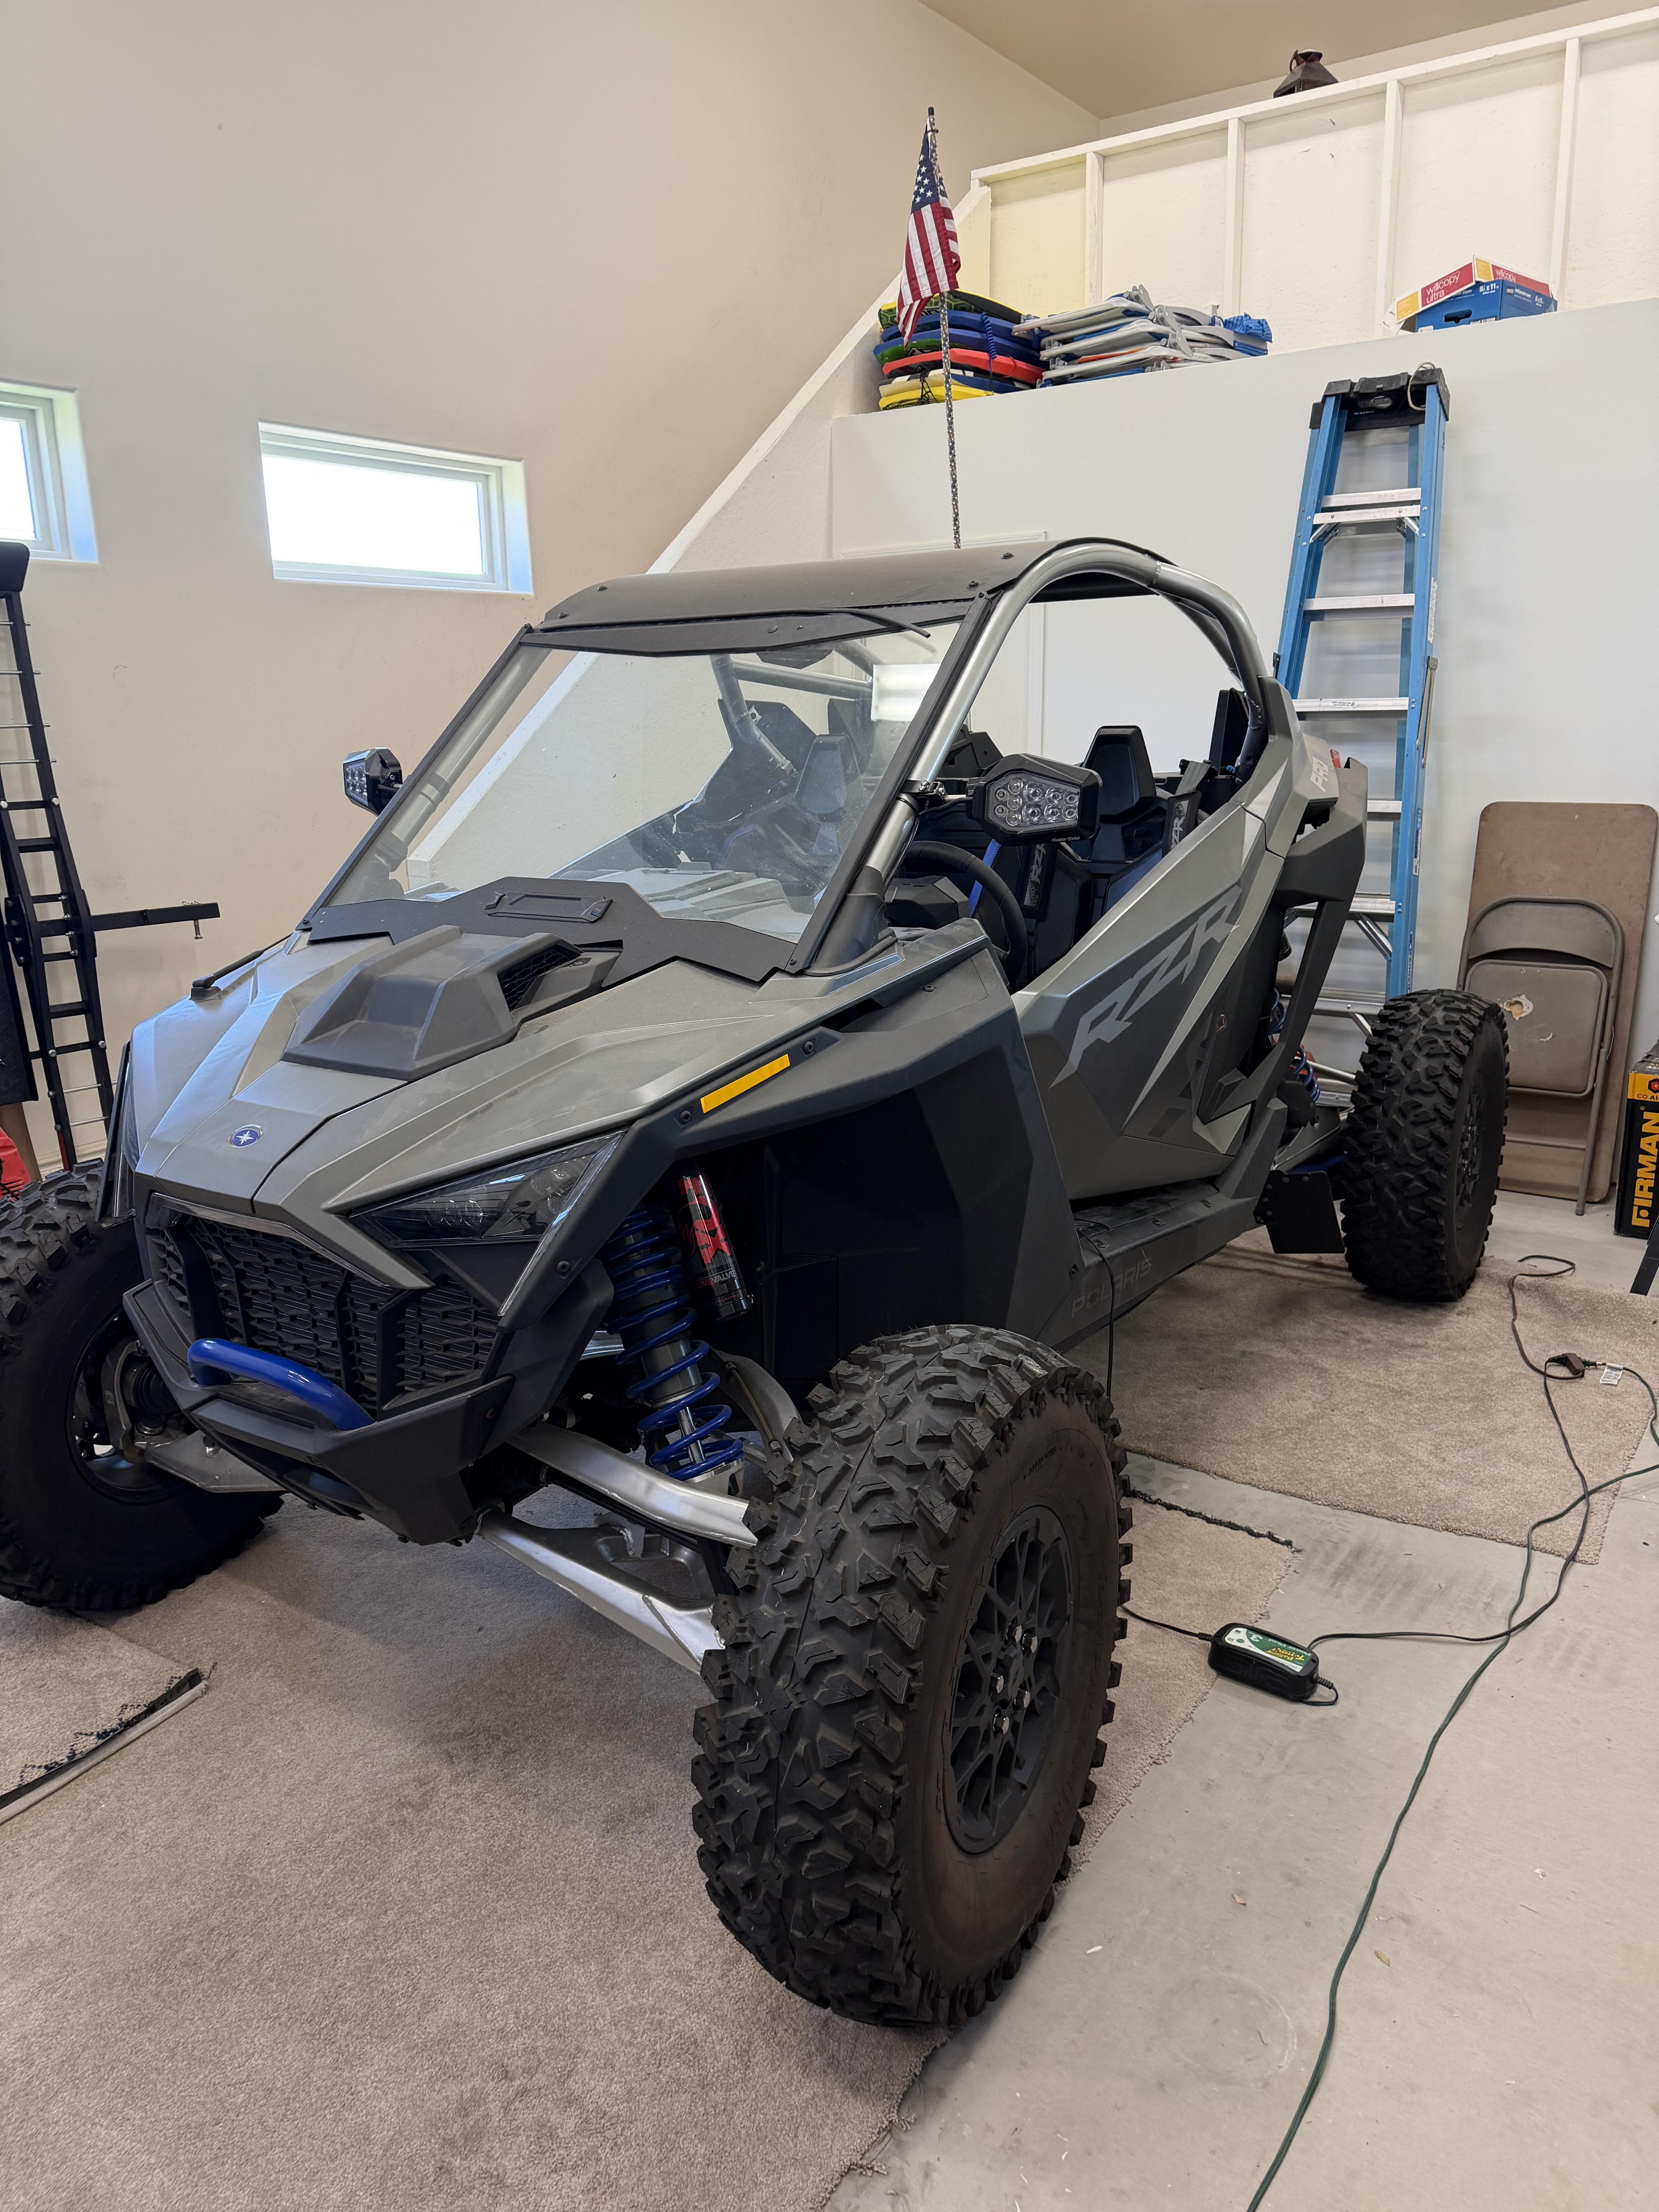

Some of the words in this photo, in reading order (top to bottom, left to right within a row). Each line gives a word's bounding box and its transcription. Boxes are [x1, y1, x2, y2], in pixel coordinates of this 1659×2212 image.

[1426, 271, 1460, 295] willcopy
[1427, 289, 1445, 304] ultra
[1310, 756, 1328, 793] PRO
[1049, 885, 1242, 1089] RZR
[1631, 1111, 1659, 1228] FIRMAN
[1071, 1257, 1152, 1319] POLARIS
